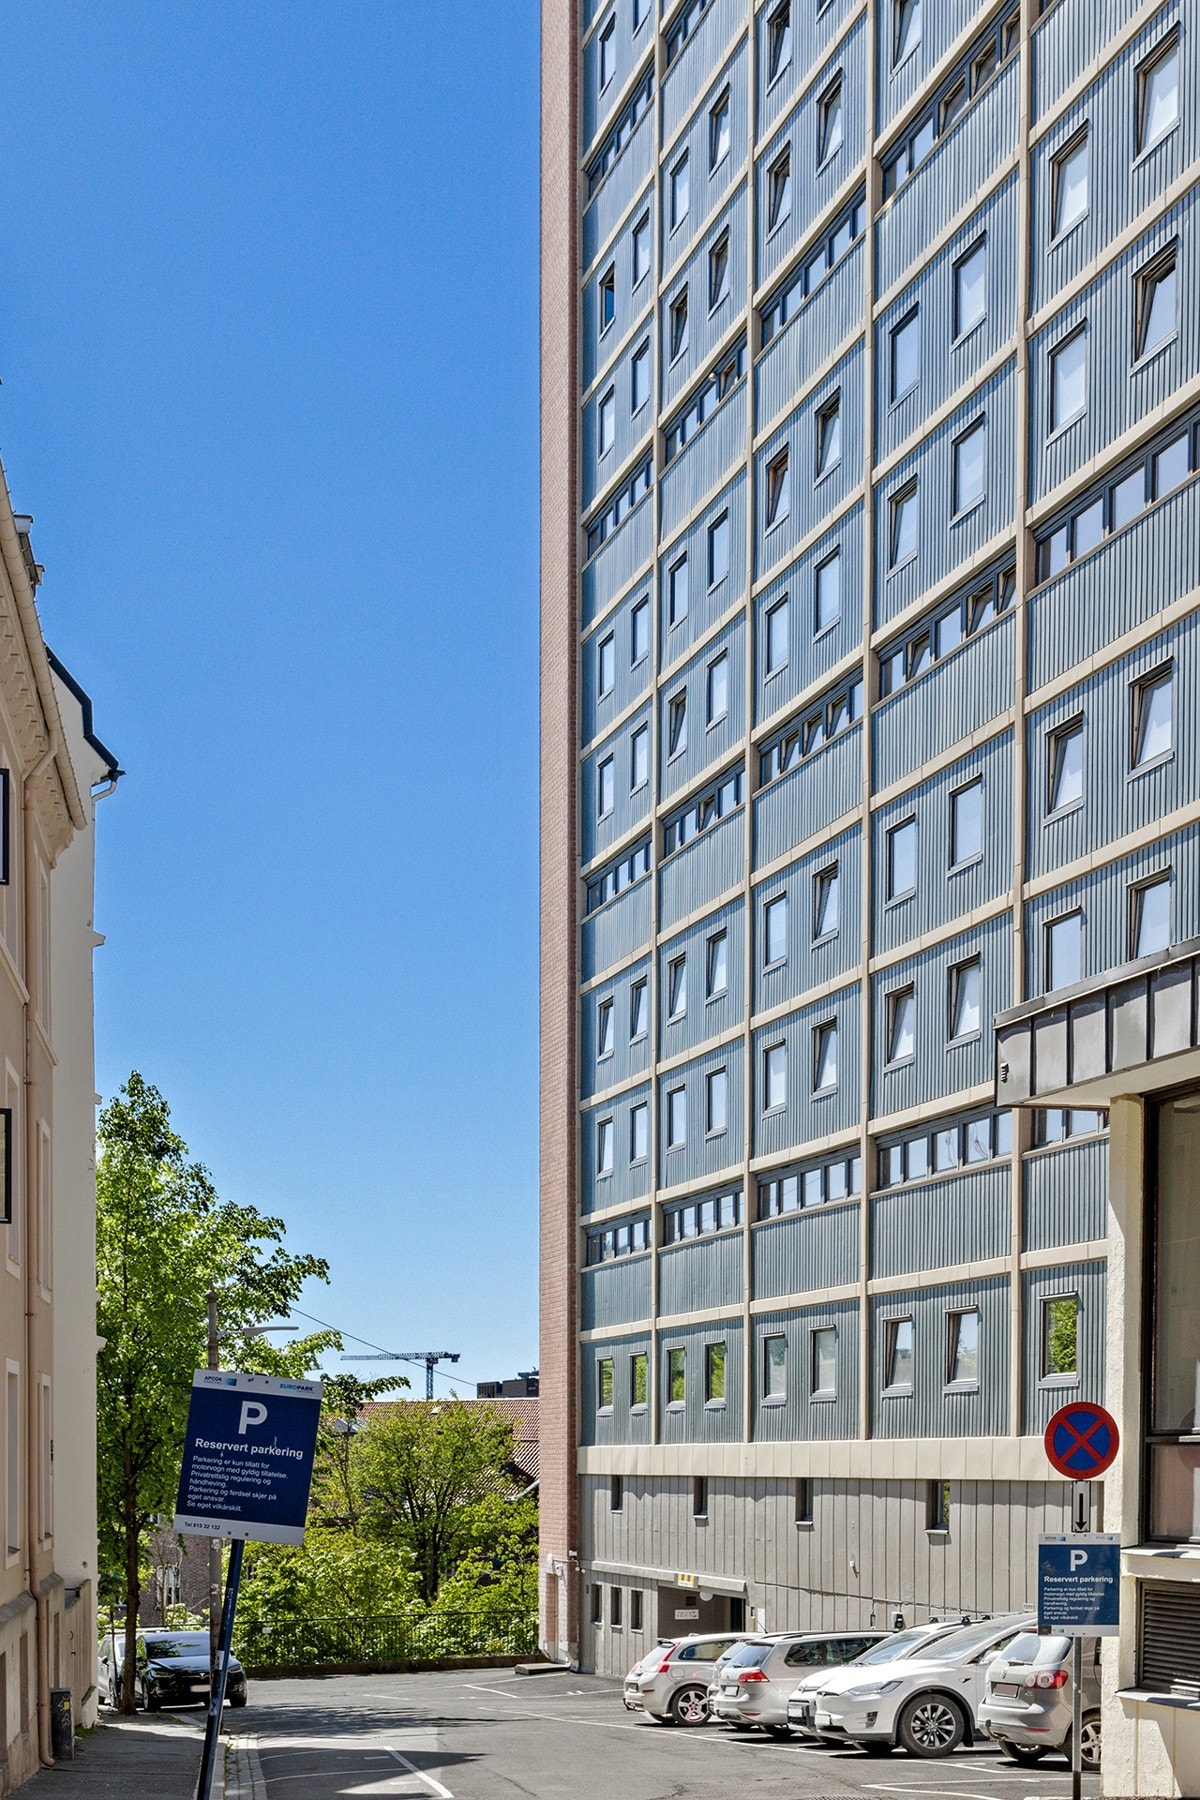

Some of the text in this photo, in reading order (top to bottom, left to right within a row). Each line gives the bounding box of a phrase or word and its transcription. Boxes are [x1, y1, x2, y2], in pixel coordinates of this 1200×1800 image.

[280, 1383, 313, 1392] EUROPARK
[238, 1400, 268, 1435] P
[195, 1438, 303, 1459] Reservert parkering
[193, 1456, 222, 1465] Parkering
[192, 1464, 225, 1473] motorvogn
[241, 1469, 260, 1477] gyldig
[190, 1478, 227, 1488] håndheving.
[191, 1471, 229, 1481] Privatrettslig
[230, 1475, 262, 1485] regulering
[188, 1494, 202, 1502] eget
[189, 1486, 219, 1495] Parkering
[252, 1492, 267, 1500] skjer
[187, 1500, 196, 1508] Se
[213, 1503, 242, 1511] vilkårskilt.
[1070, 1550, 1088, 1571] P
